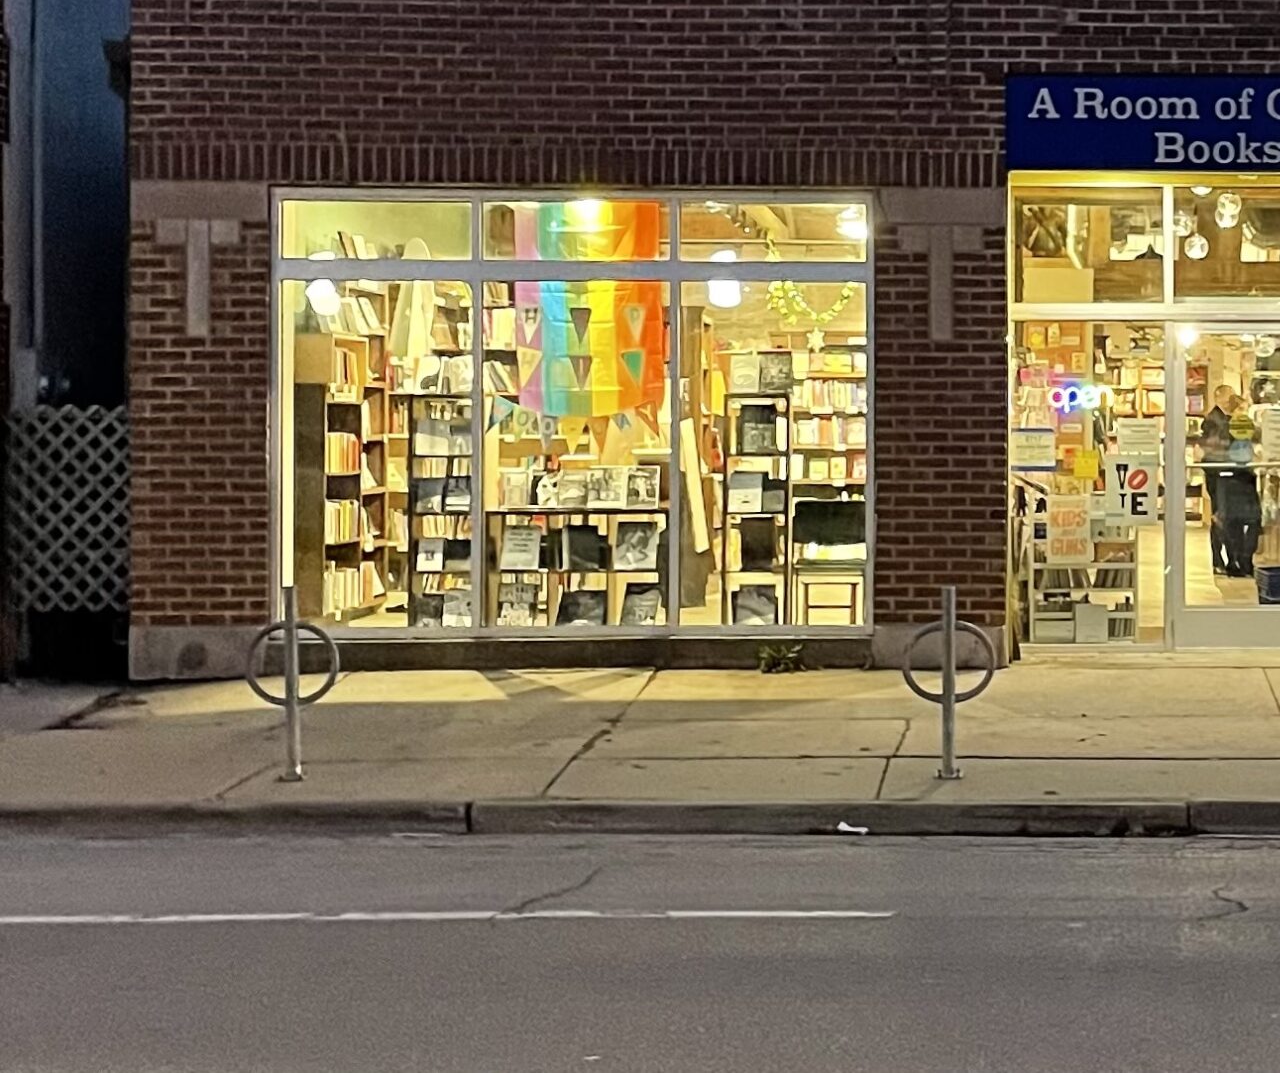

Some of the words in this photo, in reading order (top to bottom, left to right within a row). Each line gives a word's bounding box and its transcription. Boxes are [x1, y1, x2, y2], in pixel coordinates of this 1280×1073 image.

[1027, 87, 1061, 119] A
[1073, 87, 1200, 120] Room
[1214, 87, 1255, 120] of
[1048, 385, 1114, 413] open
[1051, 510, 1088, 528] KIDS
